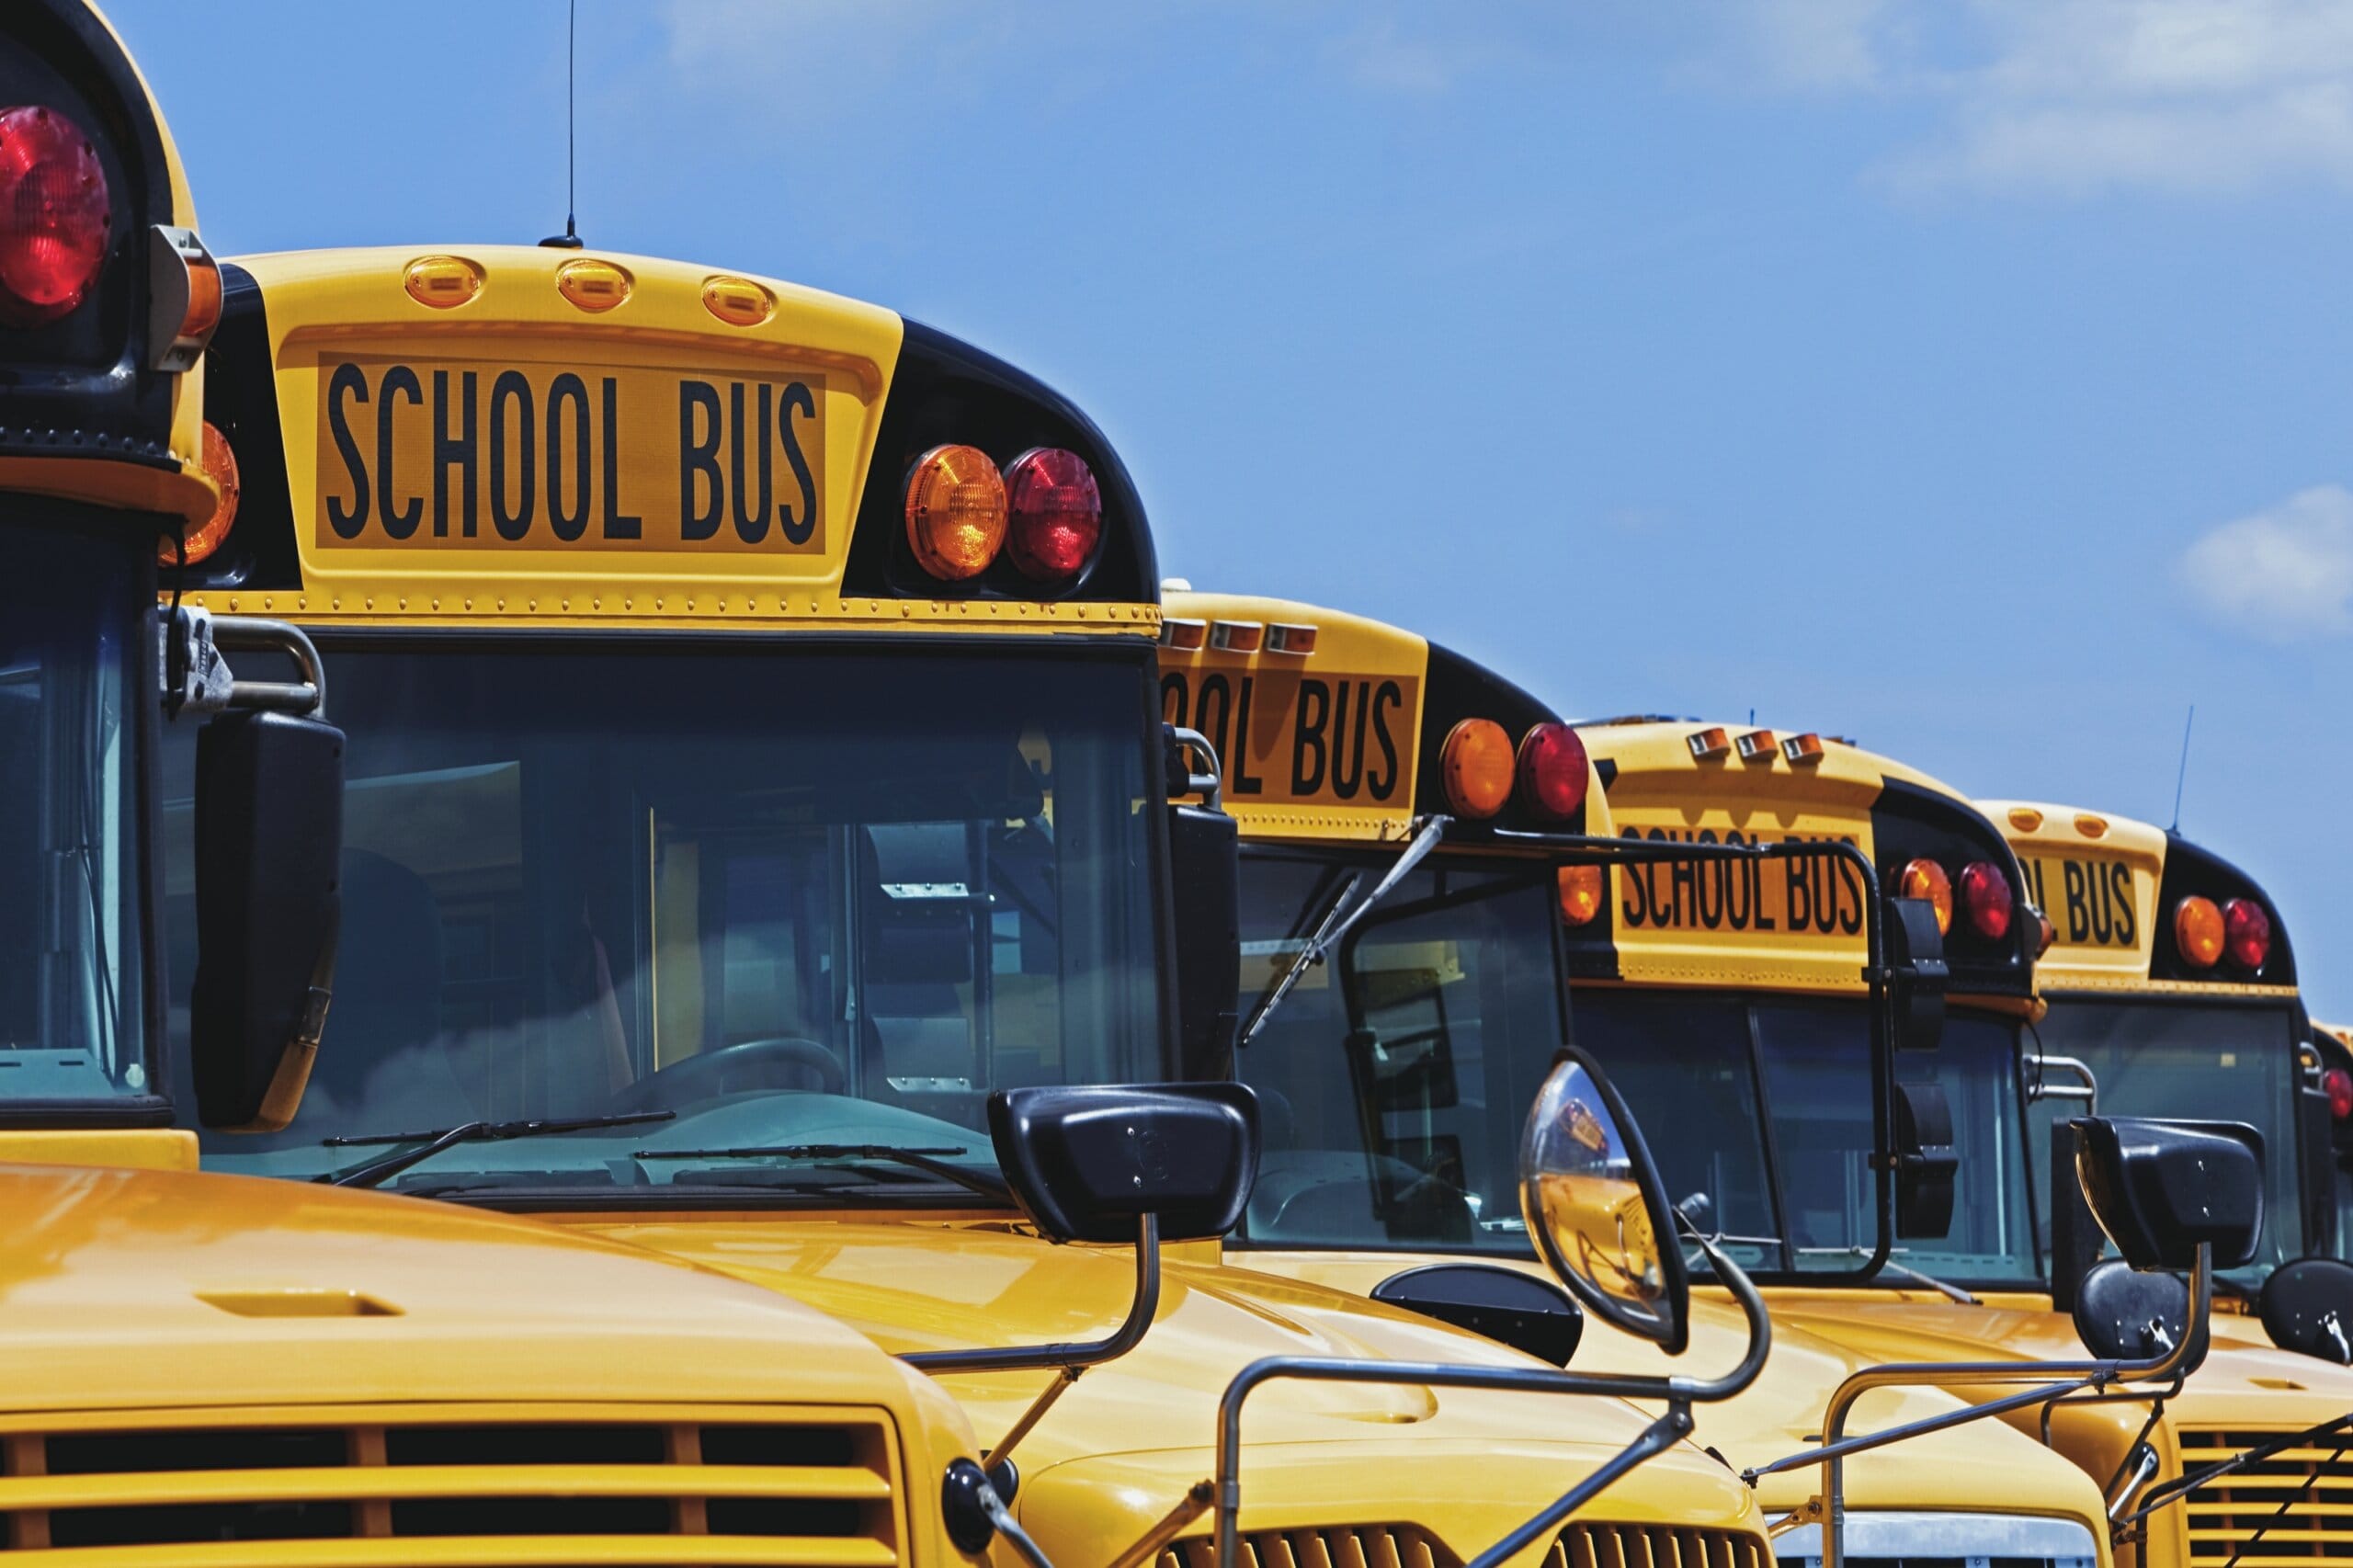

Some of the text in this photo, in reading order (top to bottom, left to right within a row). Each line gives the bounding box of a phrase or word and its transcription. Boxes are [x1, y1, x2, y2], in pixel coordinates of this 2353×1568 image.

[325, 362, 817, 545] SCHOOL BUS
[1290, 678, 1402, 801] BUS
[1621, 826, 1863, 935] SCHOOL BUS
[2063, 859, 2135, 946] BUS
